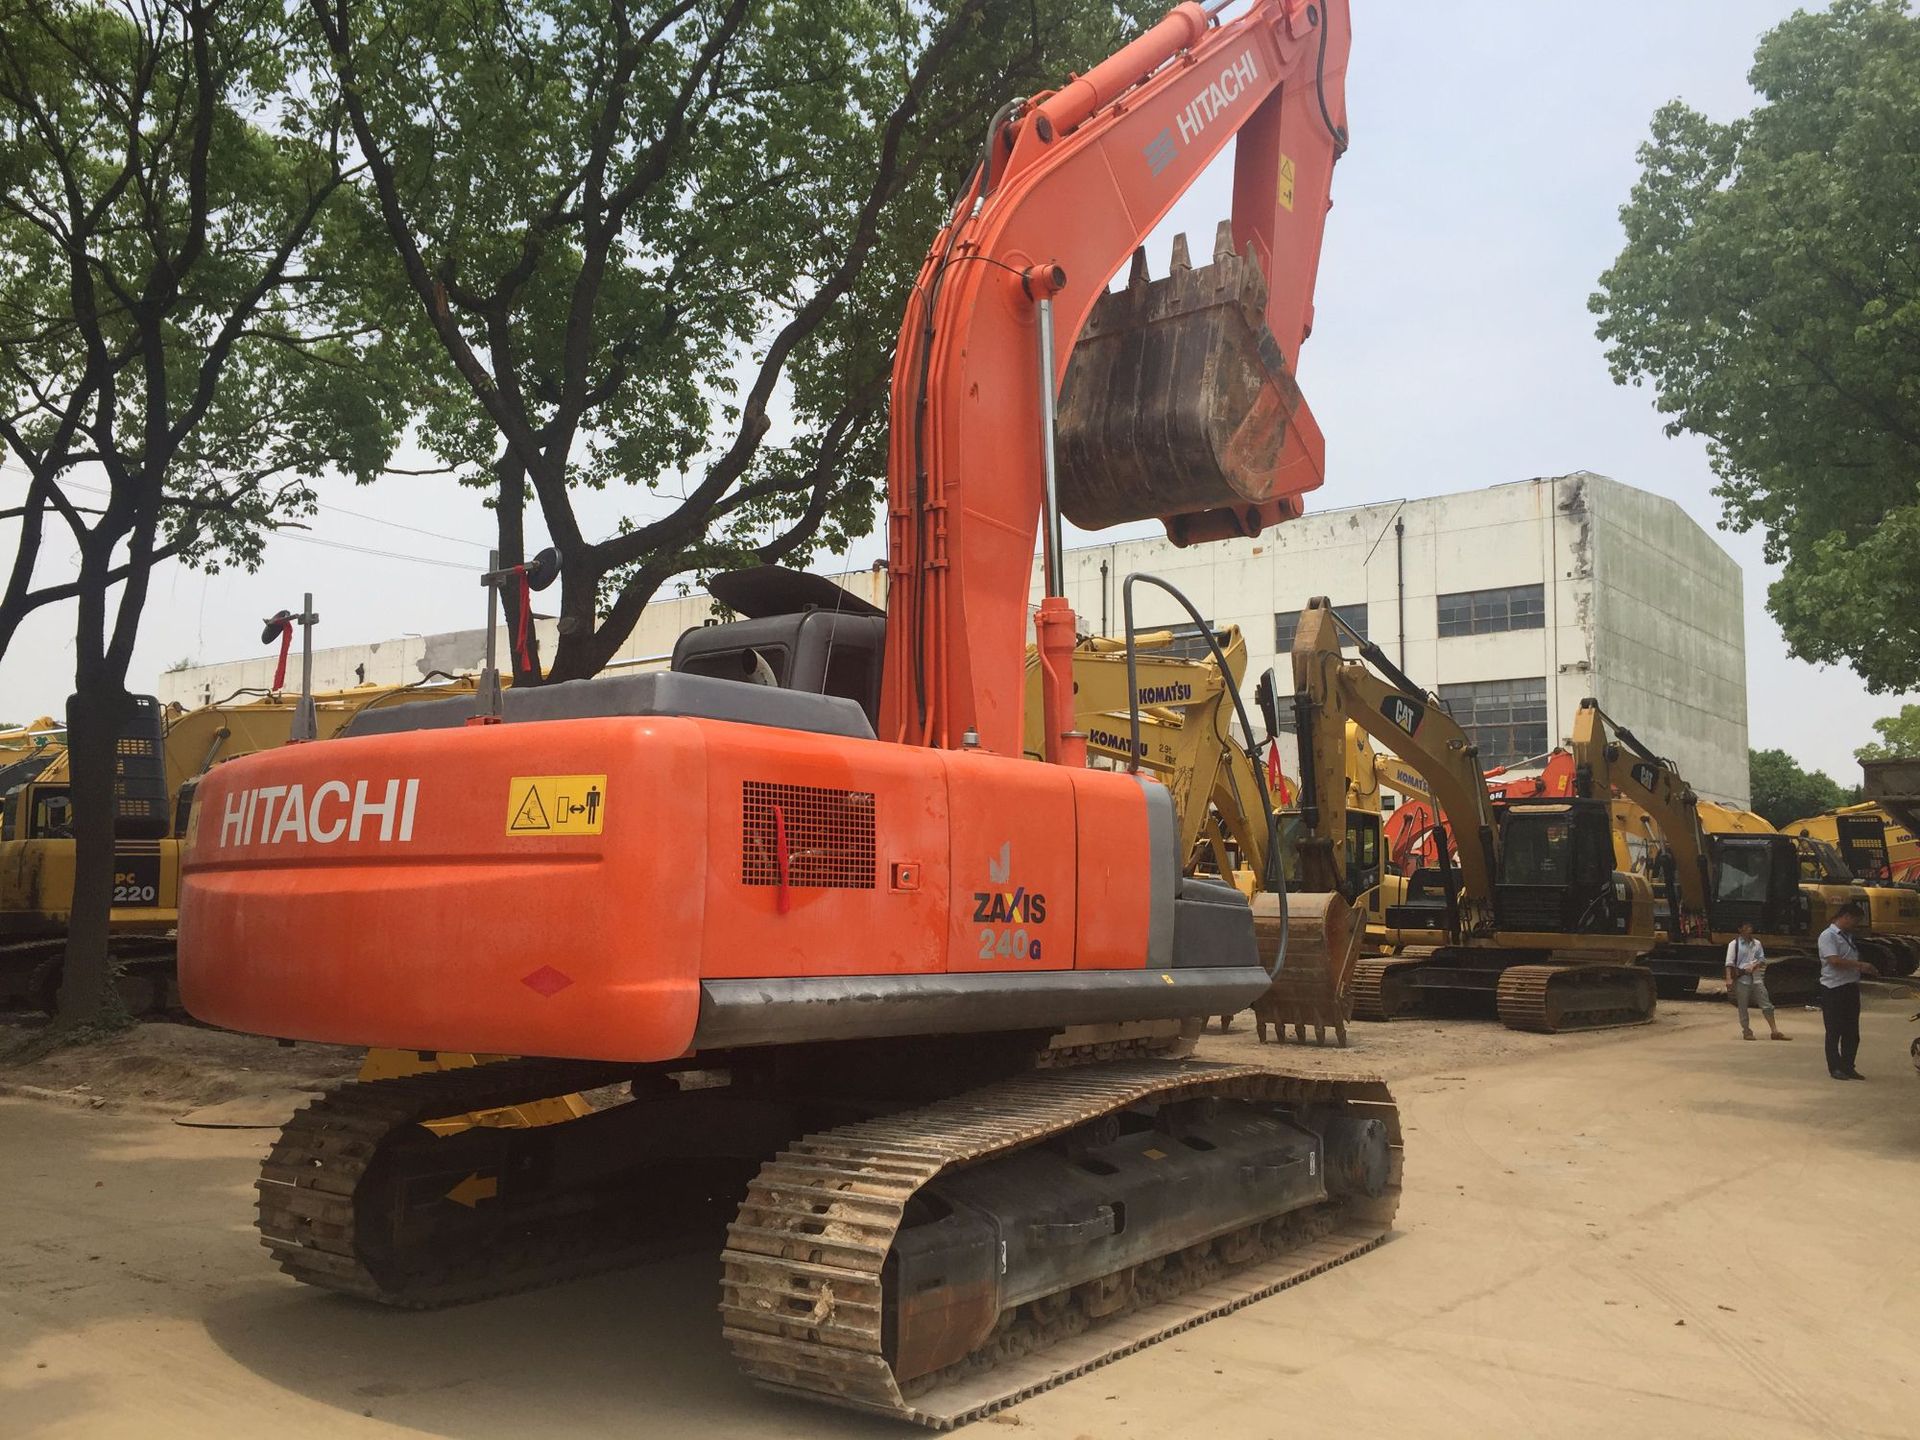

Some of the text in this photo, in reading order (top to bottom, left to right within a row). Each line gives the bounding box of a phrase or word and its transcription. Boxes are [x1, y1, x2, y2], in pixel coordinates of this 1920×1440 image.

[1176, 49, 1258, 145] HITACHI
[1138, 681, 1192, 704] KOMATSU
[1395, 699, 1414, 733] CAT
[1089, 728, 1148, 757] KOMATU
[219, 778, 420, 848] HITACHI
[113, 886, 155, 901] 220
[114, 873, 136, 885] PC
[973, 886, 1046, 924] ZAXIS
